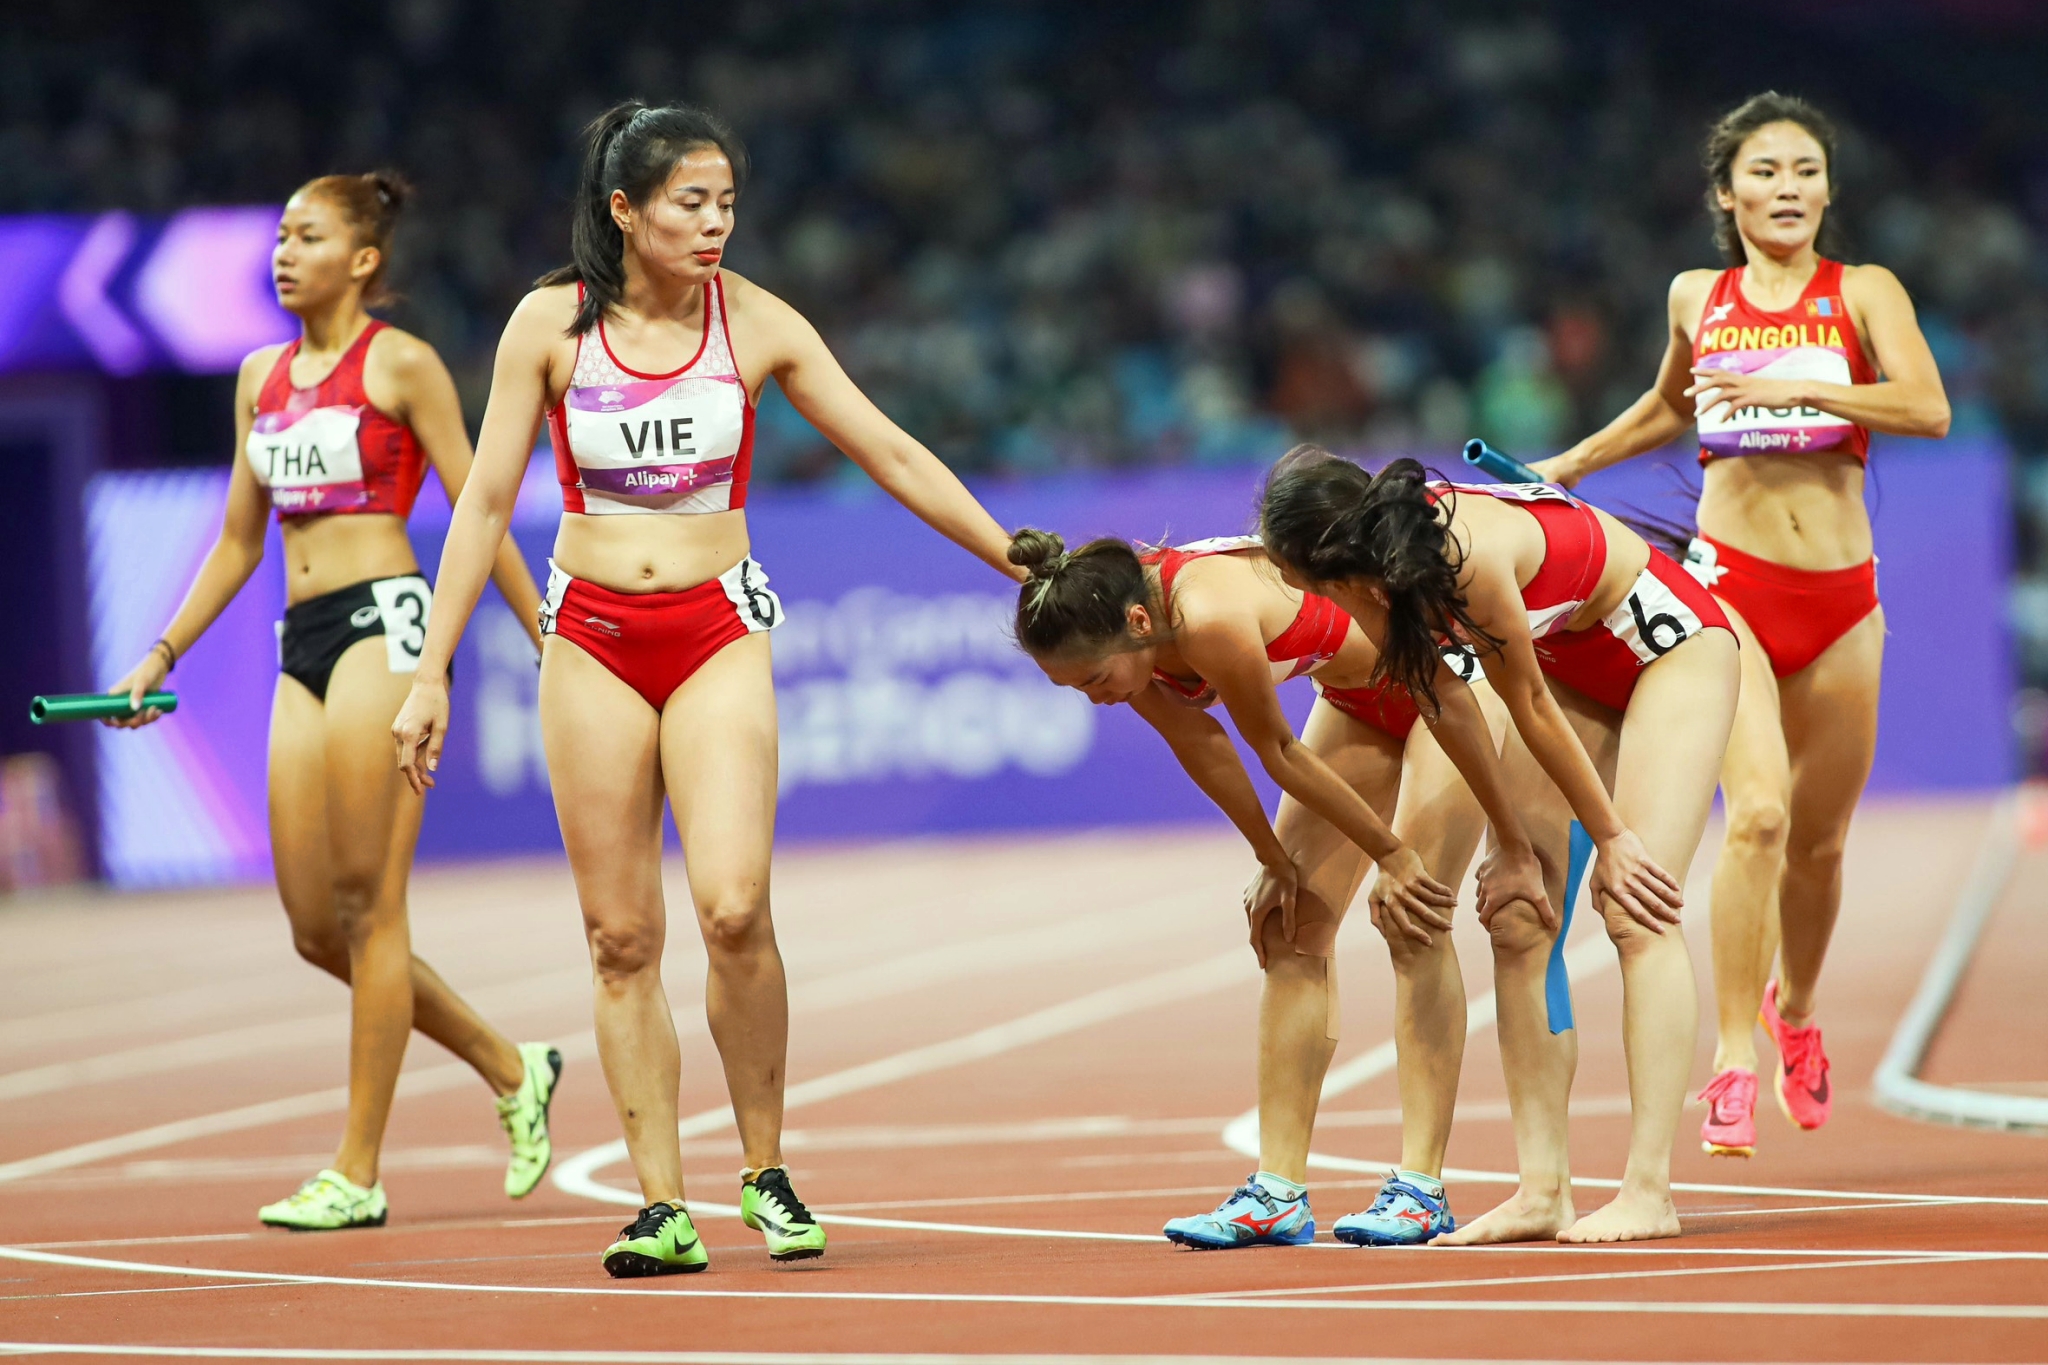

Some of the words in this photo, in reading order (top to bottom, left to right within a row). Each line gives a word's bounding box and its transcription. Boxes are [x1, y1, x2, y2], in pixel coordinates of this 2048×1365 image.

[1701, 324, 1844, 354] MONGOLIA
[619, 417, 697, 459] VIE
[1739, 431, 1791, 450] Alipay
[266, 444, 327, 477] THA
[624, 471, 680, 489] Alipay
[395, 591, 427, 657] 3
[1628, 591, 1688, 656] 6
